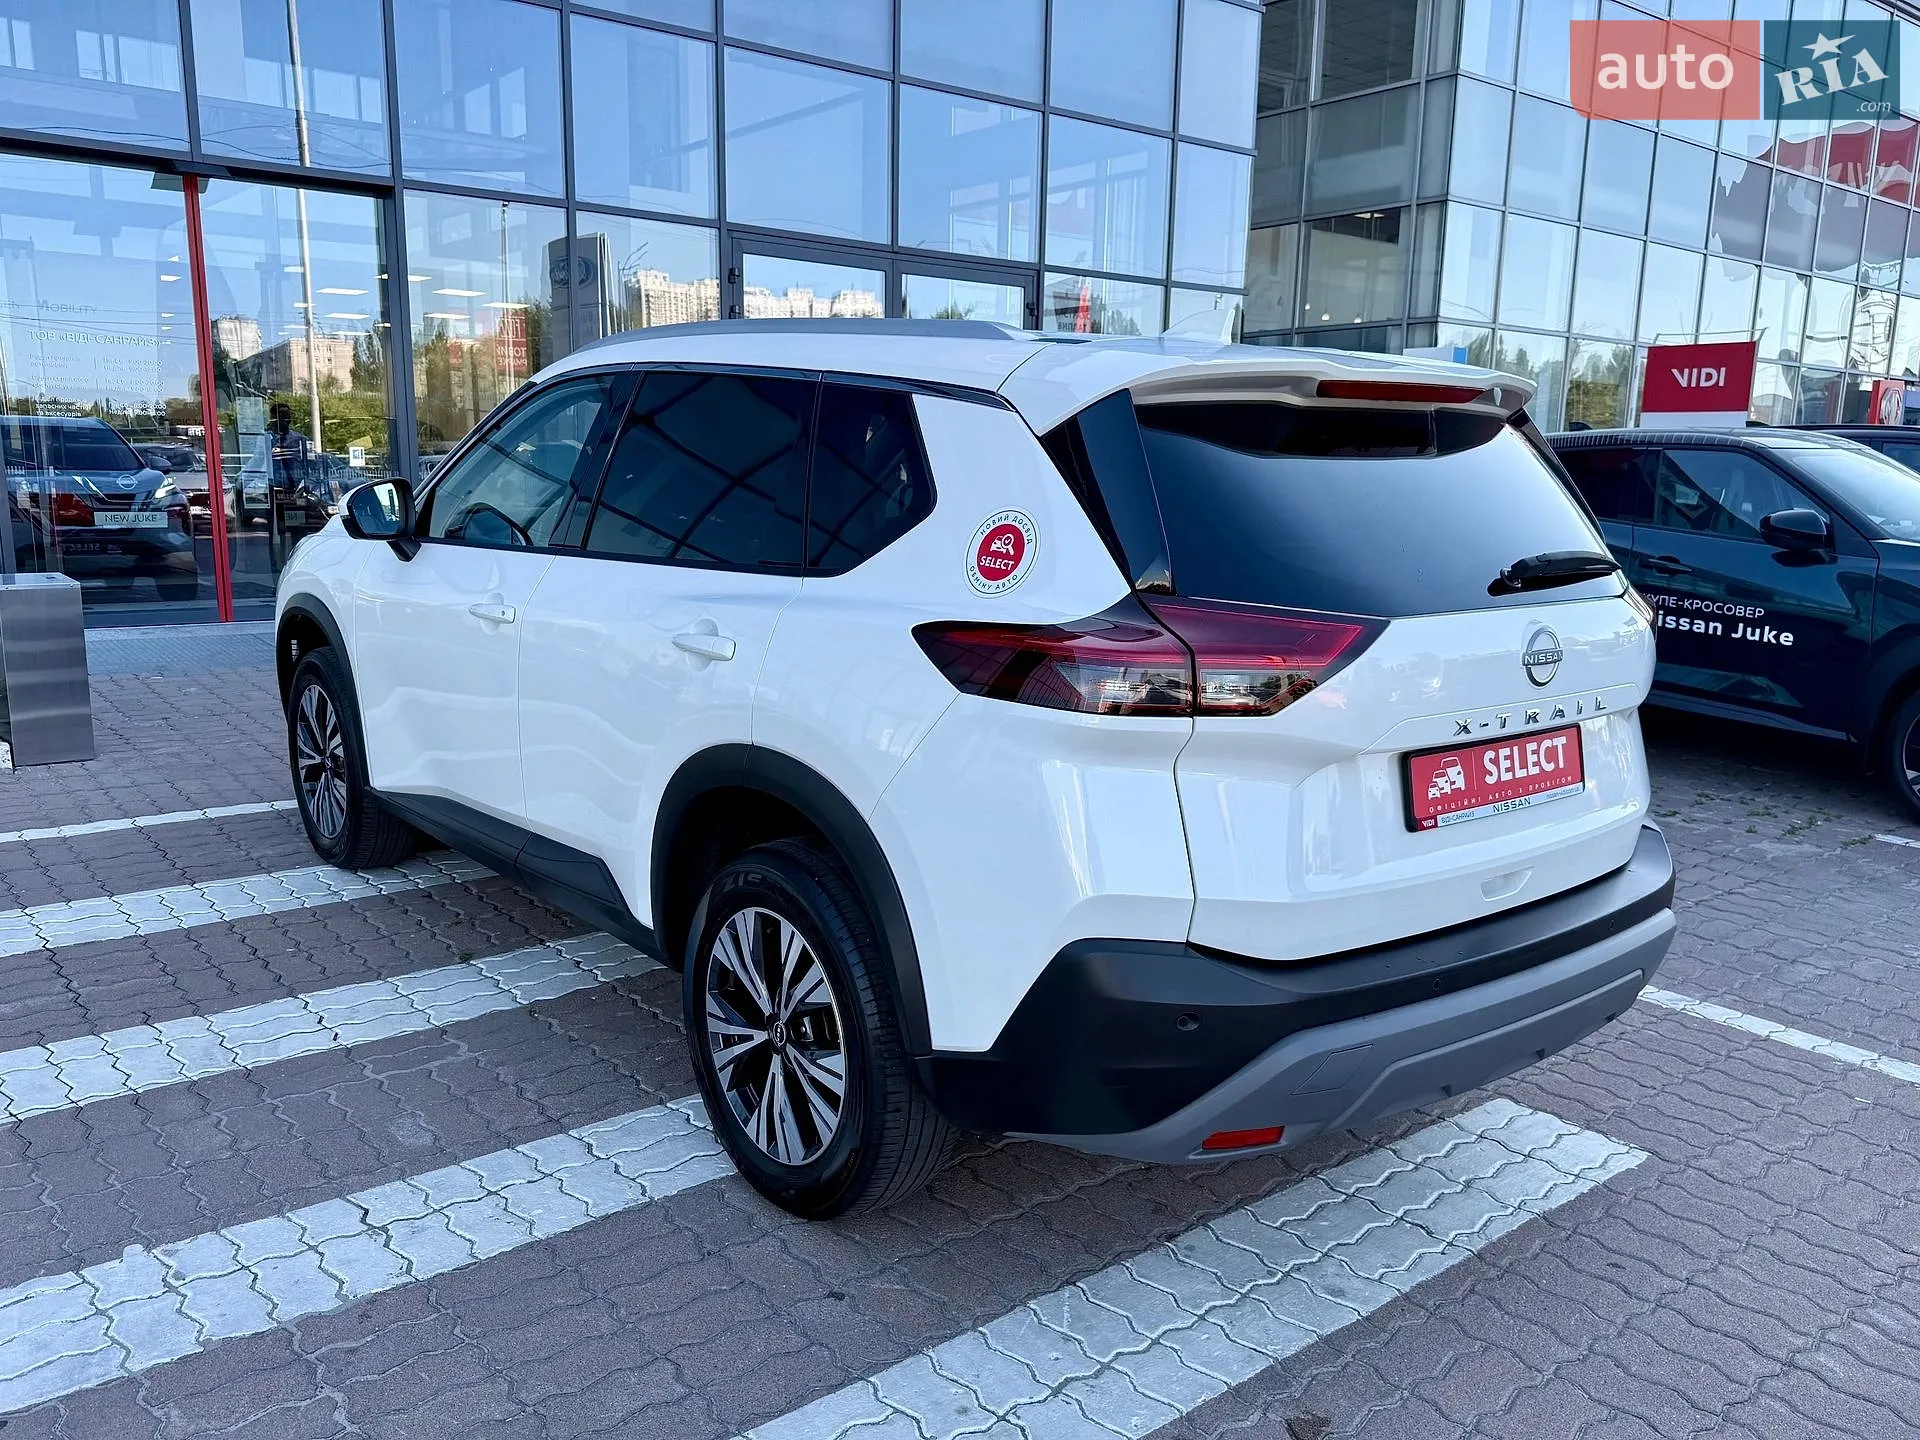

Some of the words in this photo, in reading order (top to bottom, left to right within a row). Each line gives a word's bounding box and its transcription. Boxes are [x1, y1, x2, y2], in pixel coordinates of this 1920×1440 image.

[1671, 367, 1726, 388] VIDI
[105, 513, 129, 523] NEW
[132, 513, 157, 523] JUKE
[980, 514, 1010, 536] НОВИЙ
[1011, 515, 1033, 545] ДОСВІД
[979, 555, 1015, 571] SELECT
[995, 574, 1018, 591] АВТО
[1657, 610, 1723, 636] issan
[1731, 621, 1795, 647] Juke
[1524, 650, 1562, 665] NISSAN
[1453, 696, 1607, 737] X-TRAIL
[1483, 736, 1567, 785] SELECT
[1488, 789, 1513, 801] АВТО
[1492, 797, 1532, 814] NISSAN
[1421, 819, 1435, 828] VIDI
